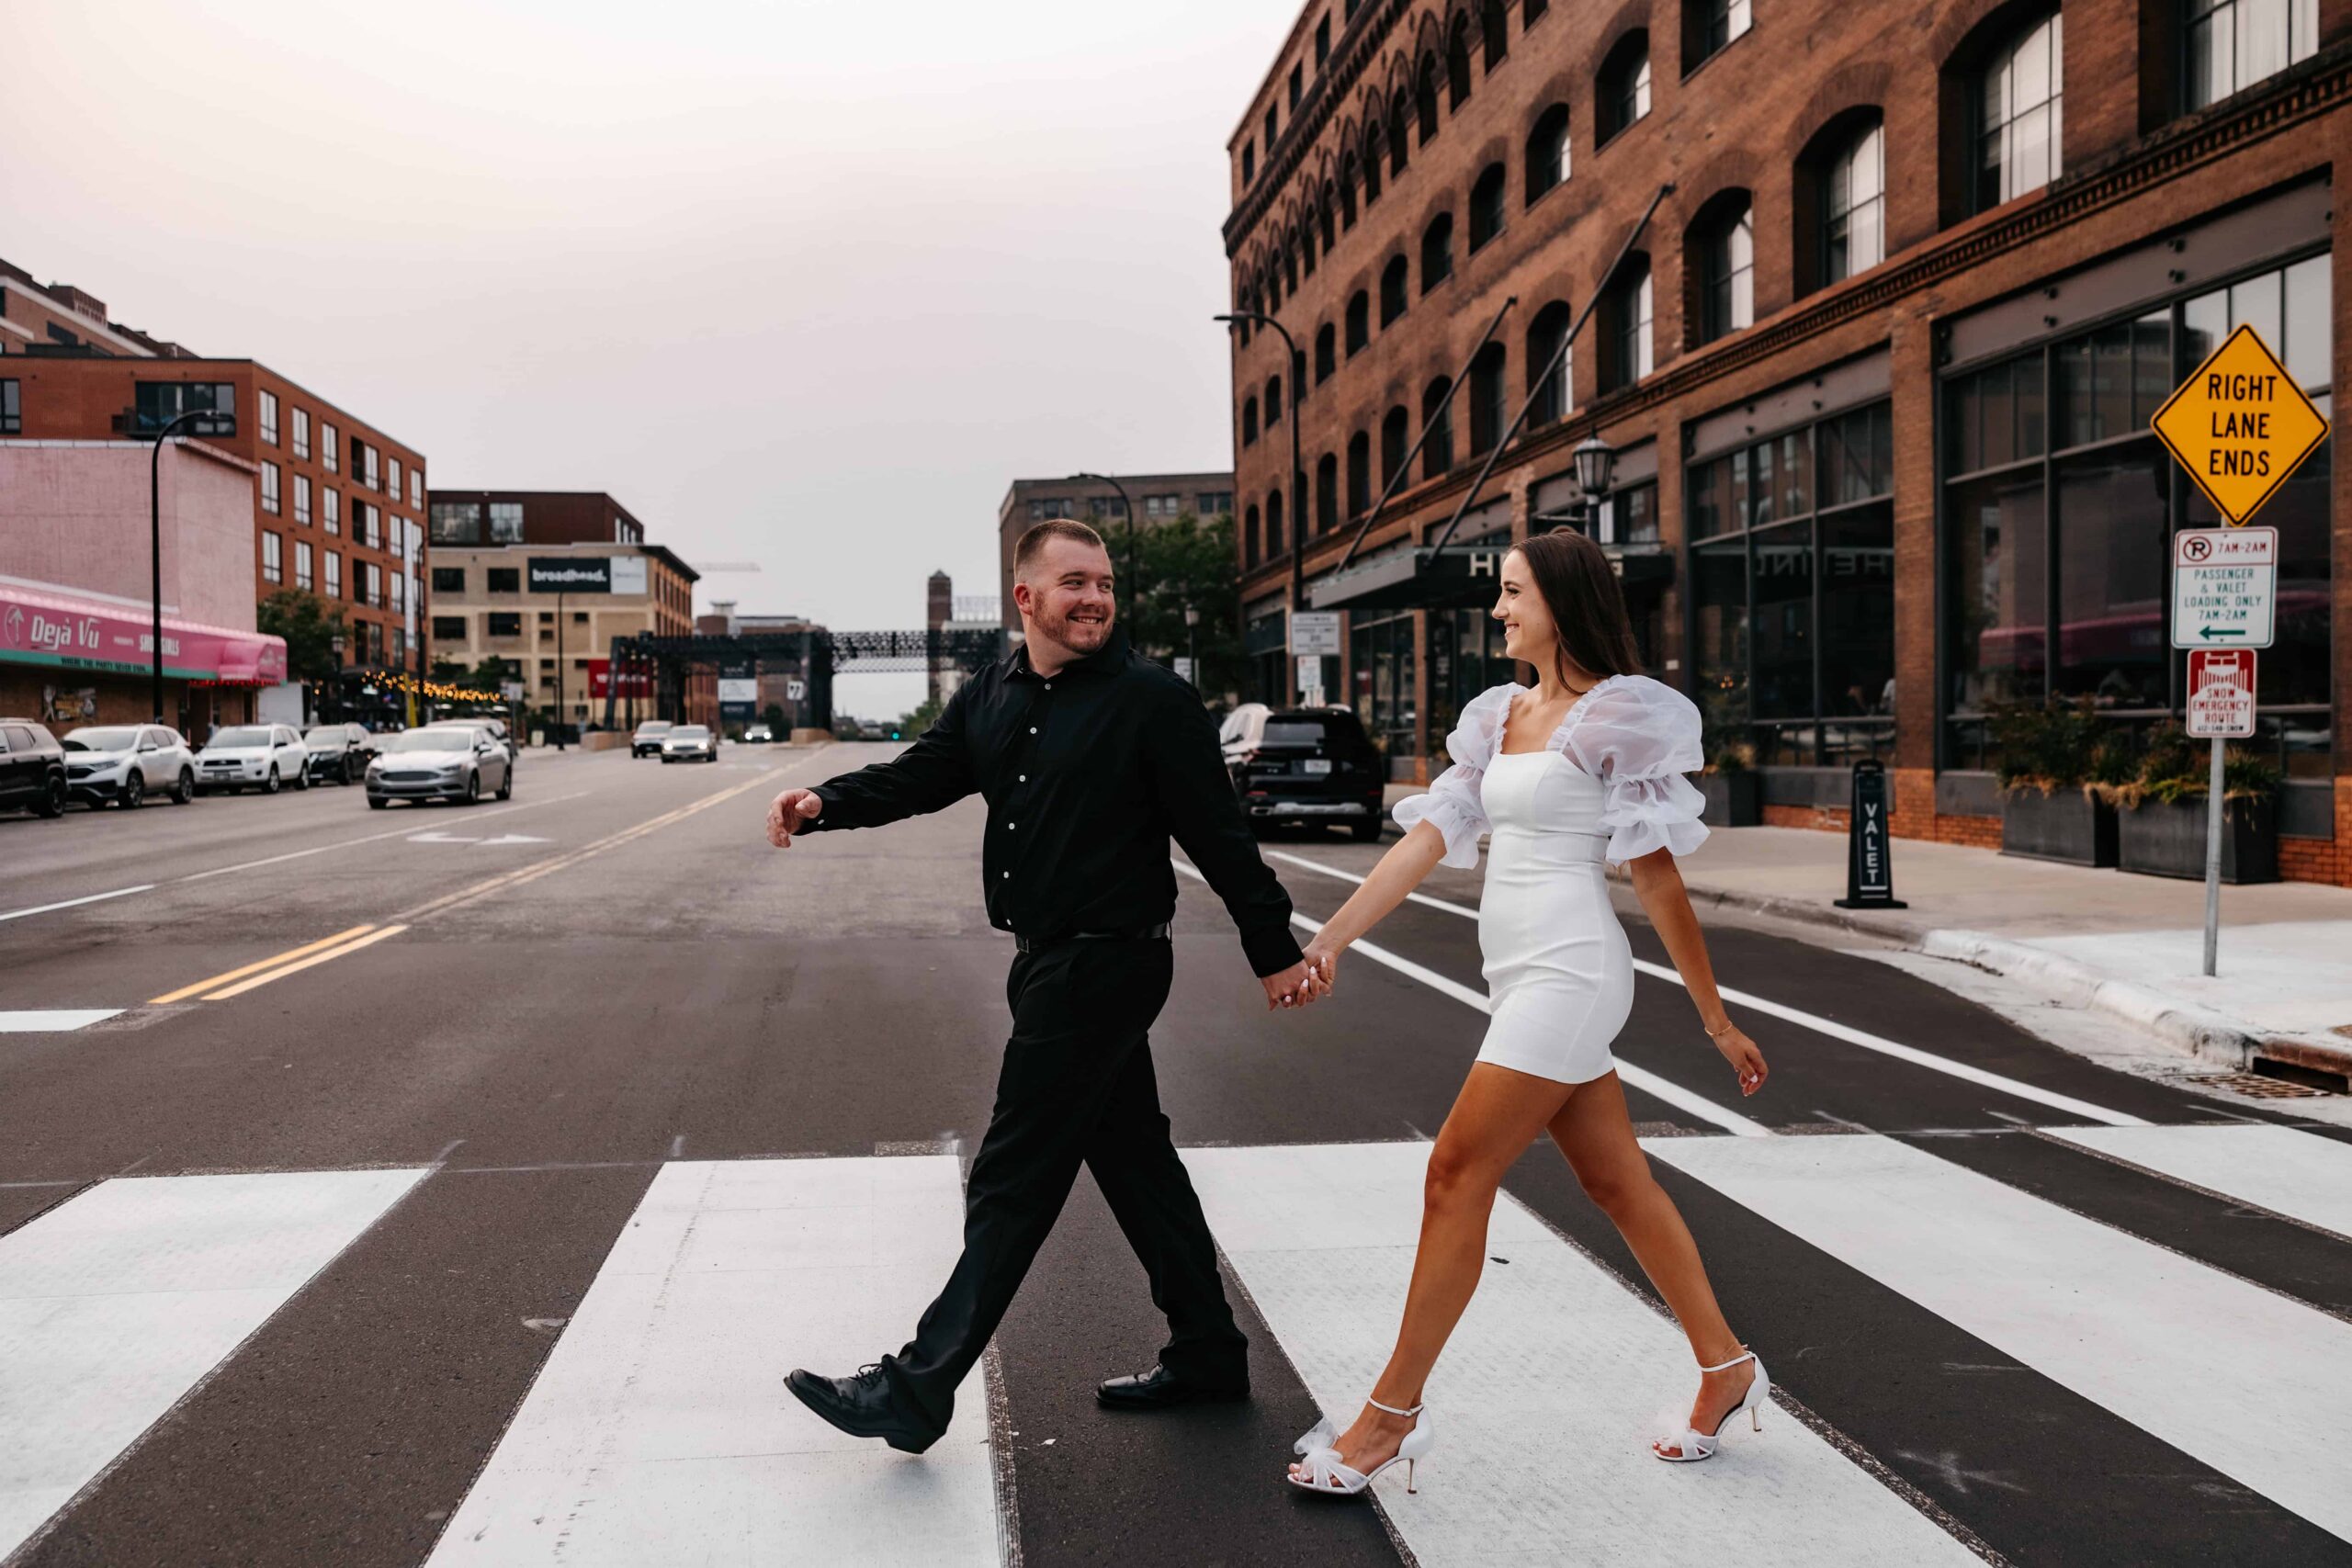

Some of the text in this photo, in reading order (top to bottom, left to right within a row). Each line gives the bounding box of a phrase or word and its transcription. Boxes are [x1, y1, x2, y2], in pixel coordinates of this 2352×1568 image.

[2208, 373, 2277, 401] RIGHT
[2211, 411, 2270, 439] LANE
[2209, 448, 2269, 476] ENDS
[2218, 543, 2267, 554] 7AM-2AM
[2194, 568, 2255, 581] PASSENGER
[2216, 581, 2247, 593] VALET
[2184, 595, 2262, 607] LOADING ONLY
[2199, 609, 2247, 621] 7AM-2AM
[78, 617, 101, 649] Vu
[140, 634, 180, 657] SHOGIRLS
[2206, 689, 2235, 699] SNOW
[2192, 701, 2249, 712] EMERGENCY
[2204, 713, 2235, 724] ROUTE
[1864, 802, 1879, 885] VALET
